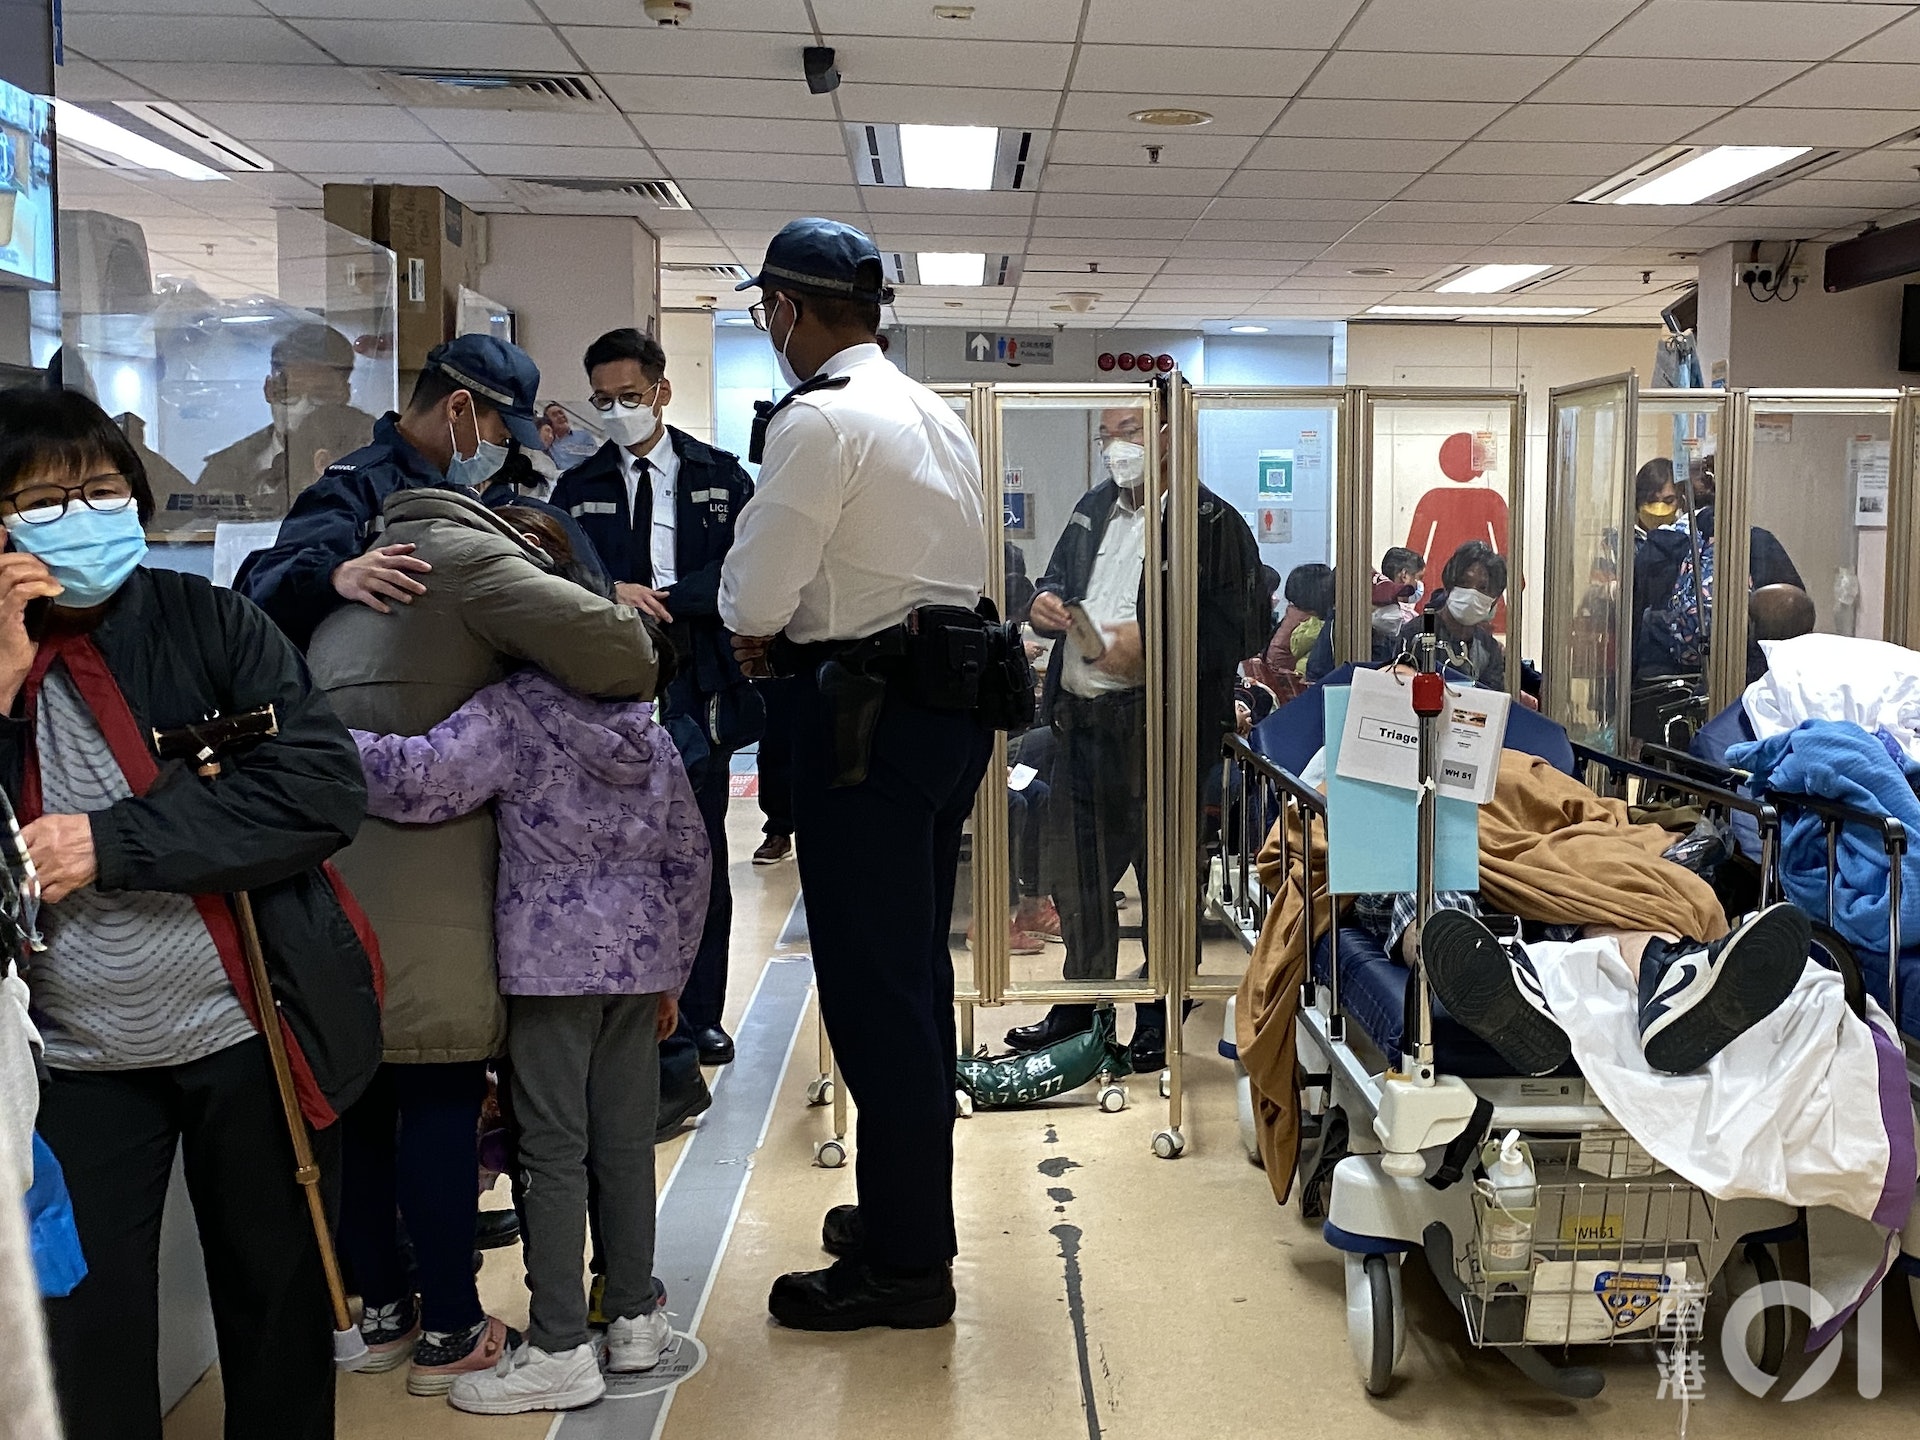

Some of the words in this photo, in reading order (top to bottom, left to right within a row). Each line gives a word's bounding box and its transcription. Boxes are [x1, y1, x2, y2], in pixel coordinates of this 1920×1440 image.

[1379, 727, 1418, 744] Triage
[1445, 768, 1460, 778] WH
[1461, 772, 1472, 781] 51
